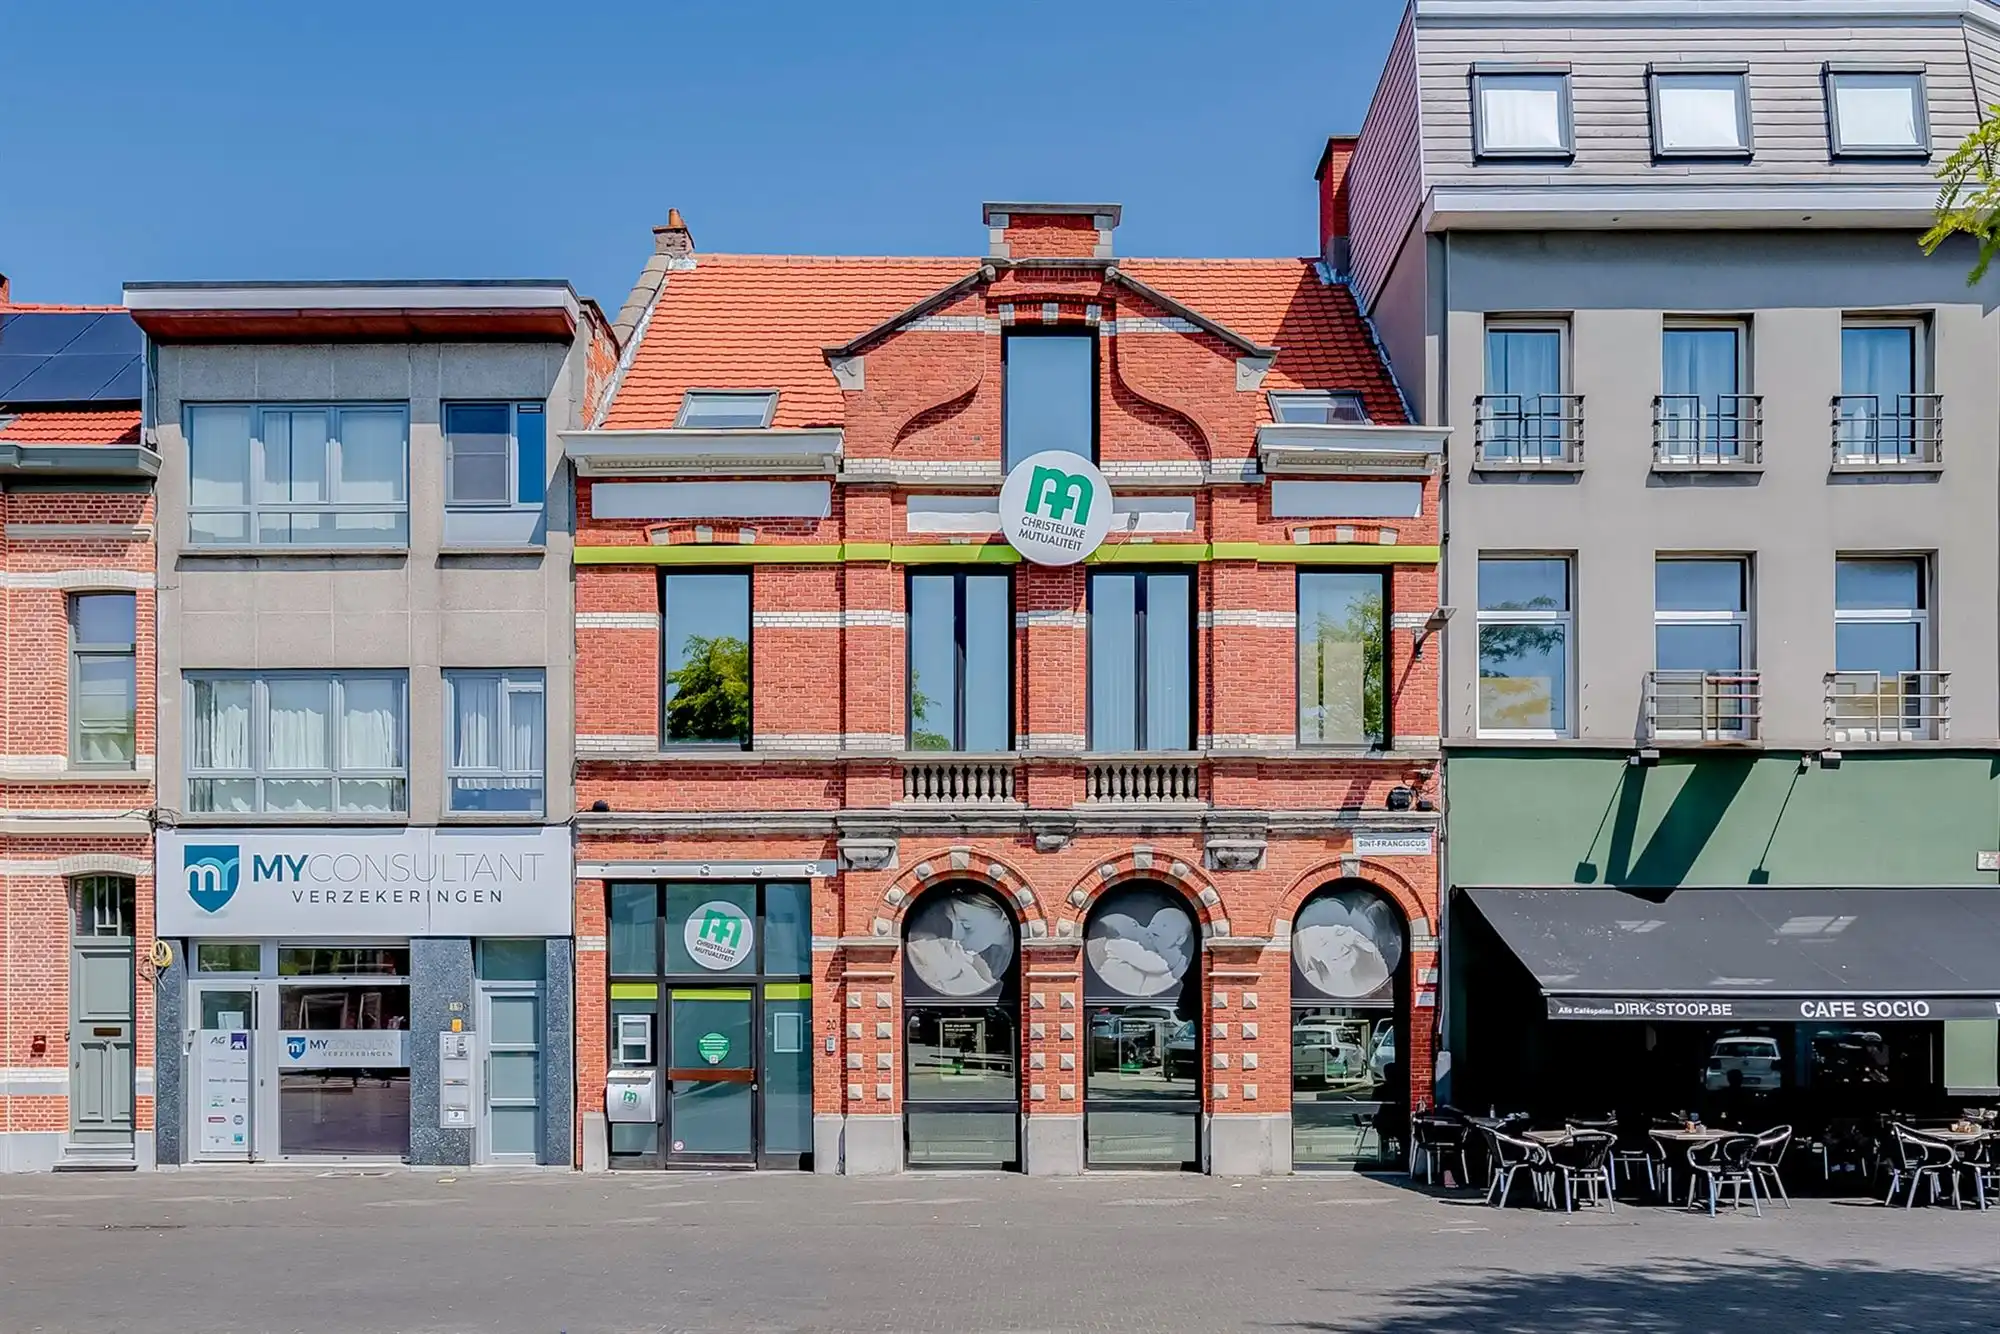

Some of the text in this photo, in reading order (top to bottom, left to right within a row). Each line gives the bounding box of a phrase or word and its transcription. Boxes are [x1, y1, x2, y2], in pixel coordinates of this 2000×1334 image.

[1021, 516, 1086, 539] CHRISTELIJKE
[1018, 528, 1083, 551] MUTUALITEIT
[253, 853, 545, 883] MYCONSULTANT
[292, 890, 502, 903] VERZEKERINGEN
[694, 946, 734, 962] MUTUALITEIT
[1614, 1003, 1733, 1015] DIRK-STOOP.BE
[1800, 1000, 1930, 1018] CAFE SOCIO
[826, 1020, 836, 1030] 20
